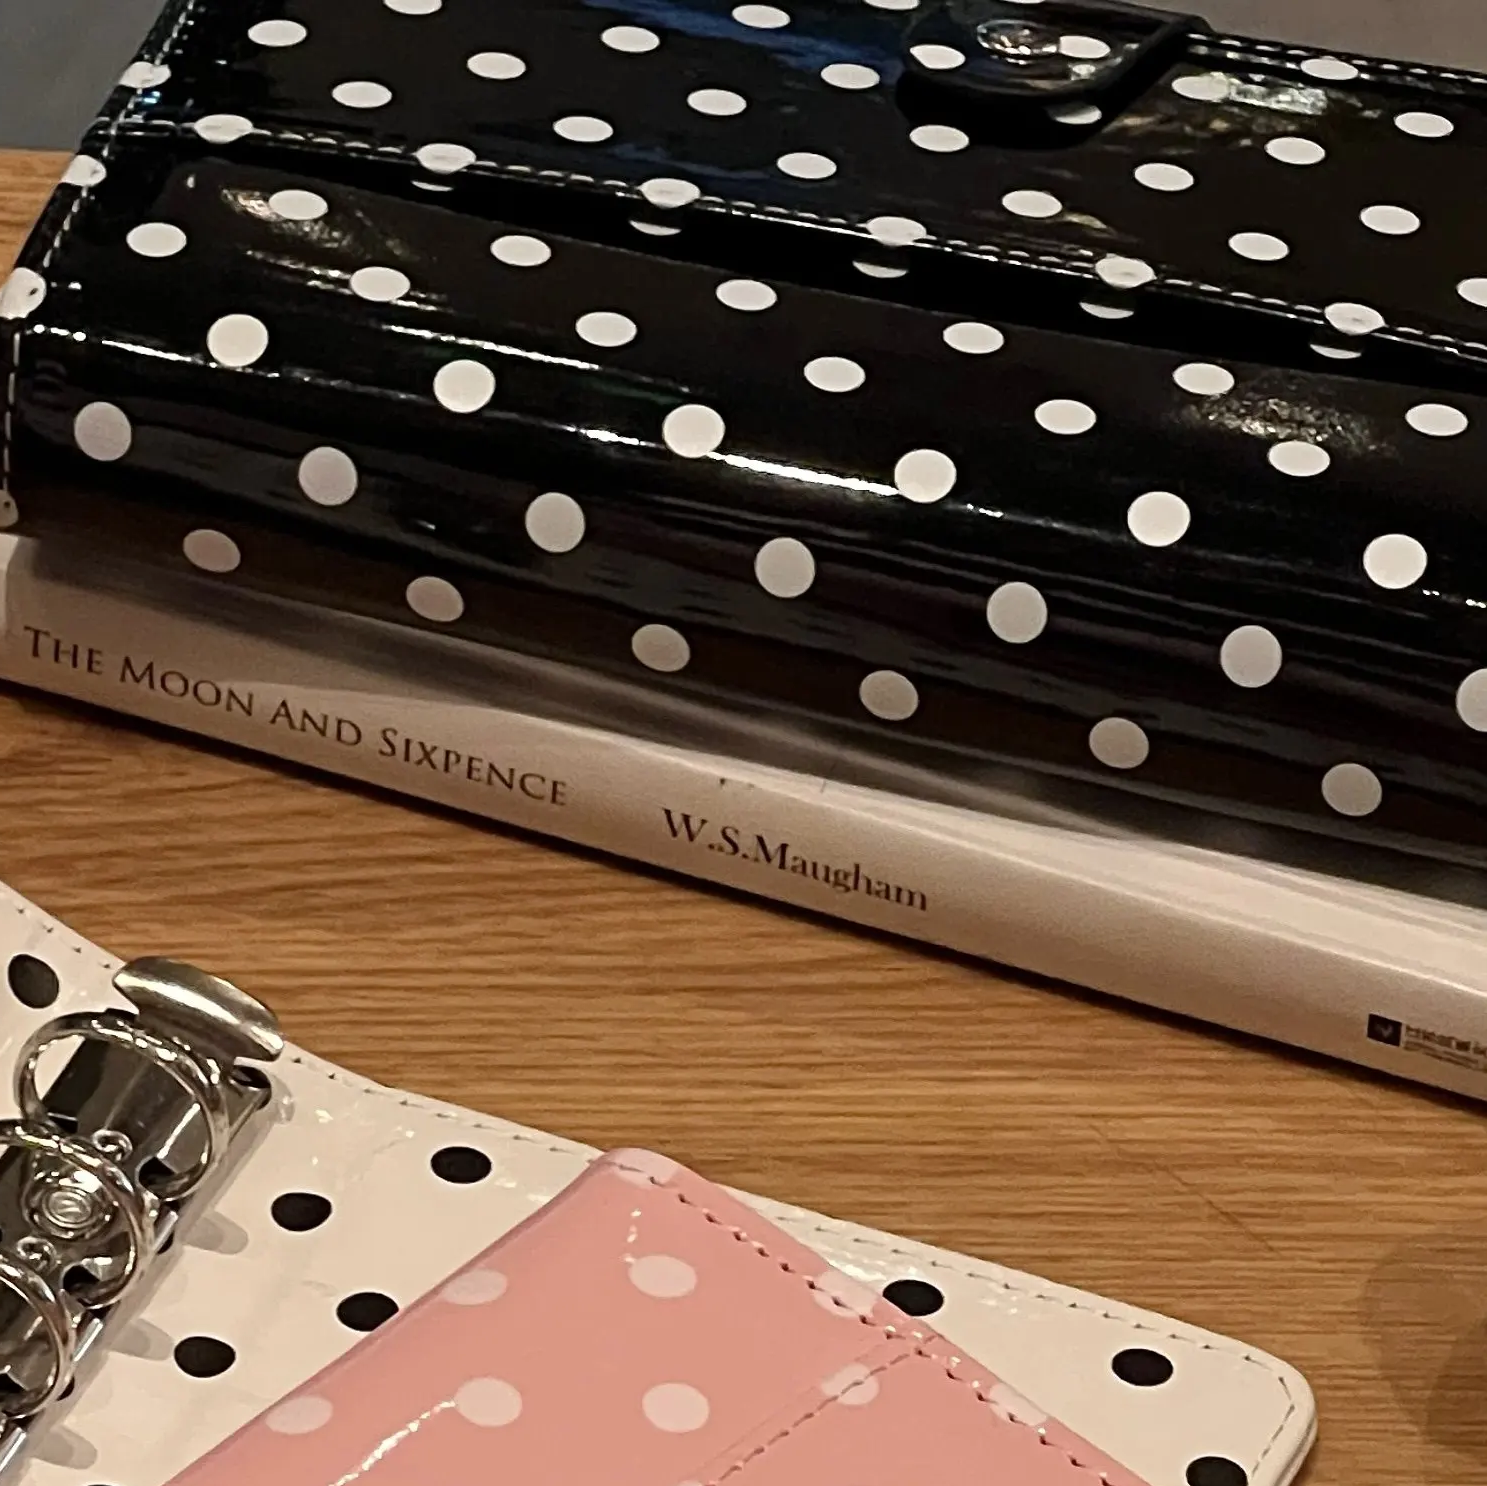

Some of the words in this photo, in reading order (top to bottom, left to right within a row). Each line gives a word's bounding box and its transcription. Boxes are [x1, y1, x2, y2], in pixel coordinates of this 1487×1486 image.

[23, 625, 103, 675] THE
[119, 656, 254, 716] MOON
[270, 699, 362, 746] AND
[378, 728, 567, 806] SIXPENCE
